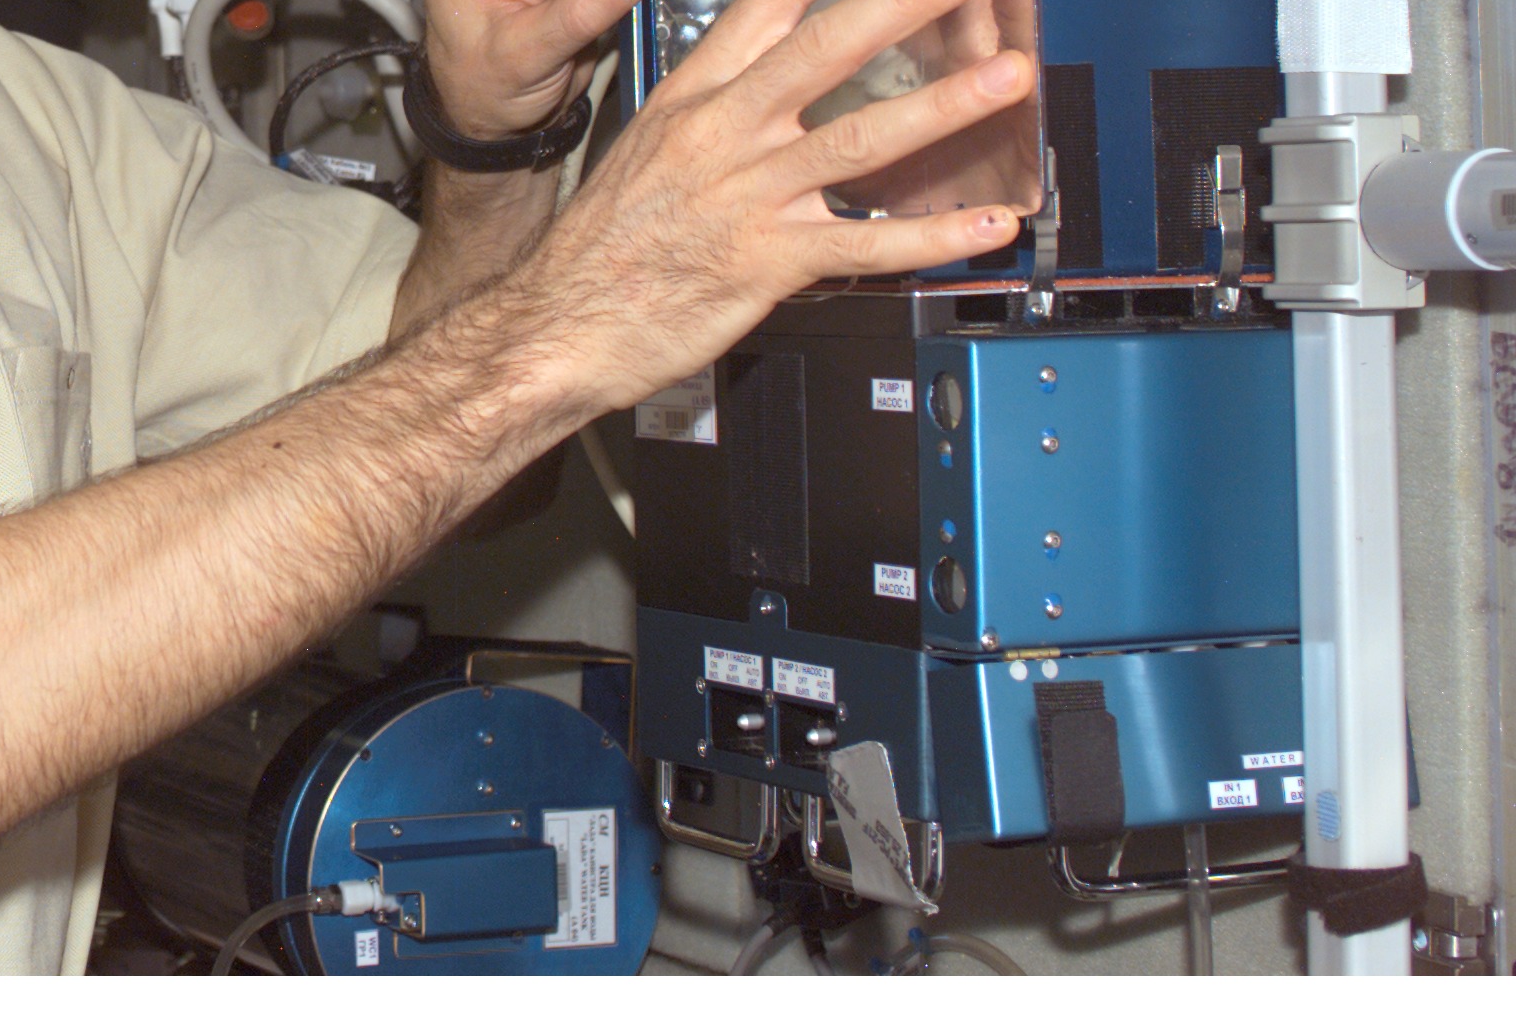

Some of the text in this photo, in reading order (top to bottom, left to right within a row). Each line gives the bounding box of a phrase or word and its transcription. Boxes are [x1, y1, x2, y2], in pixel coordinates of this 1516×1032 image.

[879, 382, 900, 393] PUMP
[876, 397, 903, 408] НАСОС
[881, 567, 908, 581] PUMP 2
[878, 582, 911, 597] НАСОС 2
[1249, 753, 1296, 766] WATER
[1224, 783, 1234, 793] IN
[1217, 795, 1244, 806] ВХОД
[580, 869, 589, 903] WATER
[598, 864, 610, 898] КЦН
[580, 904, 589, 931] TANK
